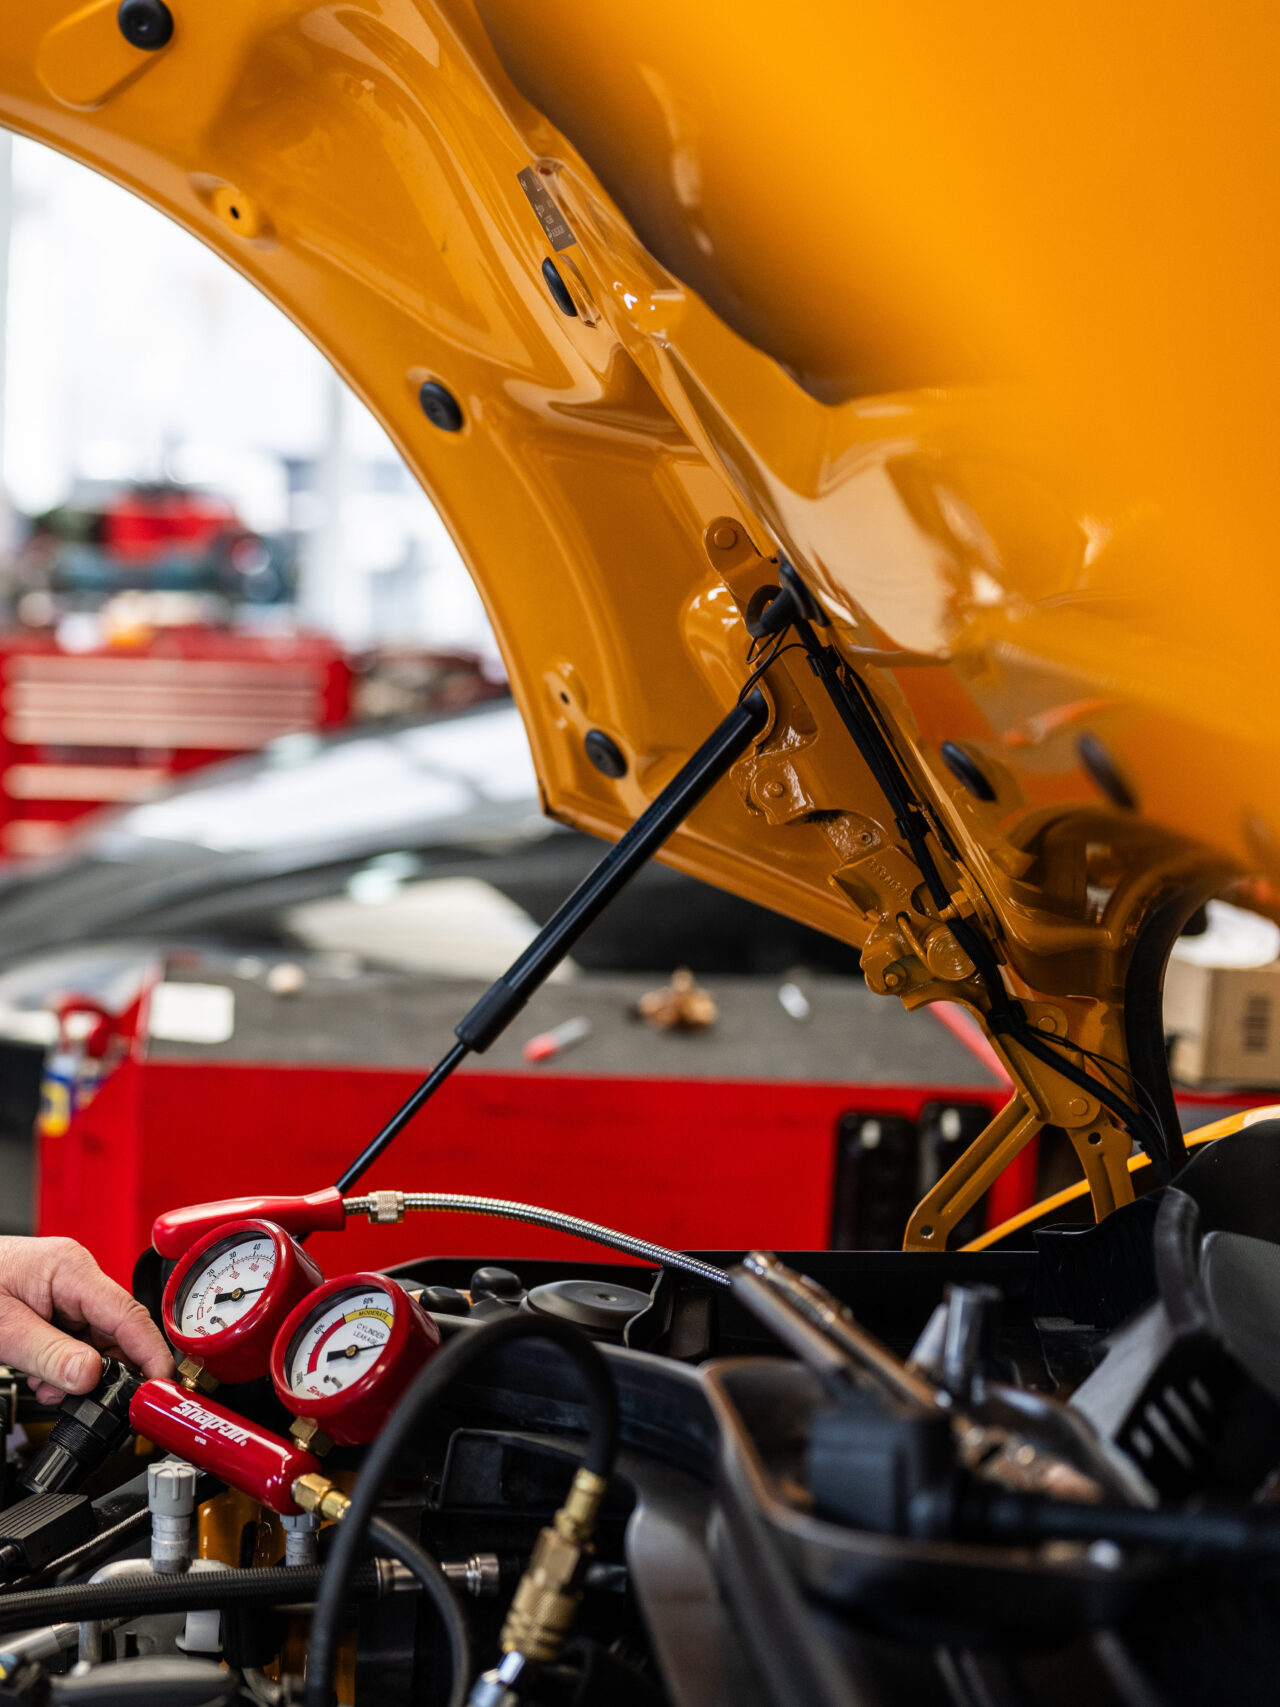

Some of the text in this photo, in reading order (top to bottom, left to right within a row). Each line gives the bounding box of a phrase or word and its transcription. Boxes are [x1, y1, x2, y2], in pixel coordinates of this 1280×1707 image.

[358, 1310, 389, 1320] MODERATE
[356, 1323, 386, 1340] CYLINDER
[171, 1400, 251, 1443] Snap-on
